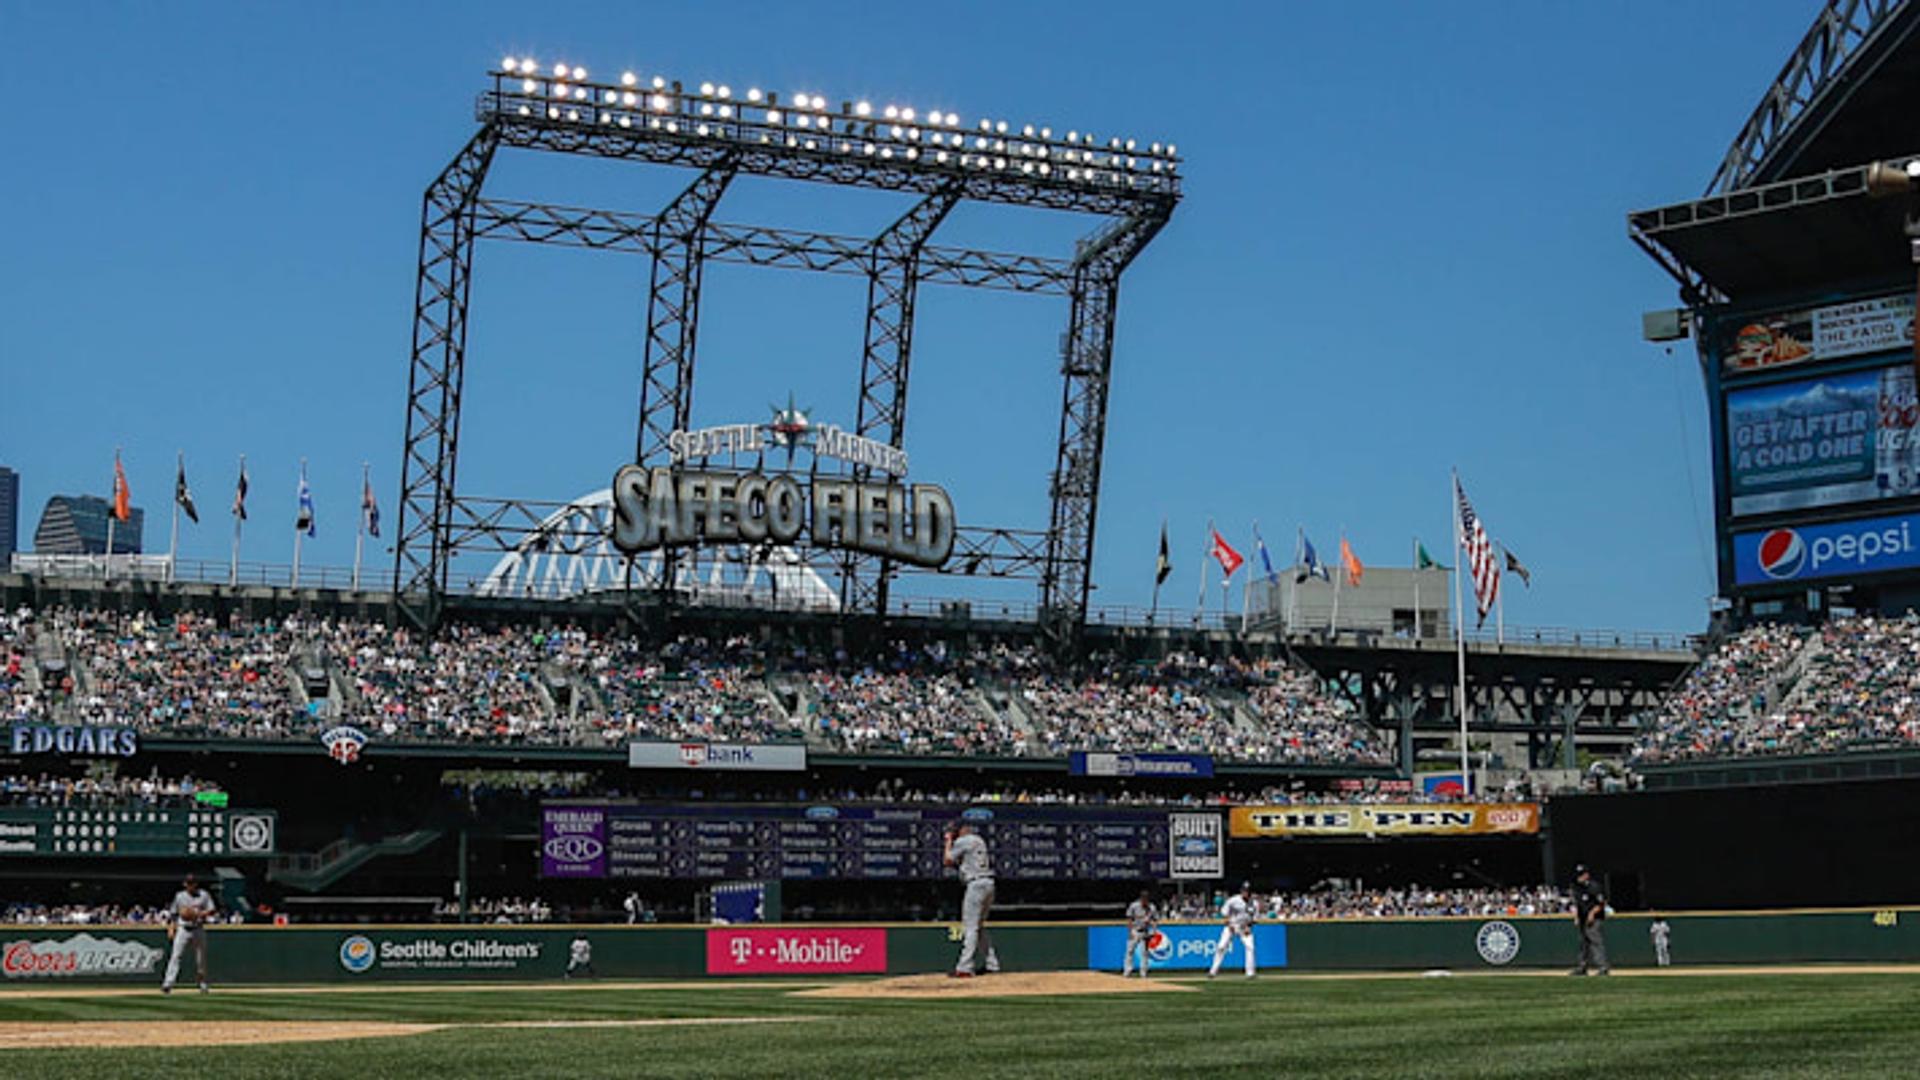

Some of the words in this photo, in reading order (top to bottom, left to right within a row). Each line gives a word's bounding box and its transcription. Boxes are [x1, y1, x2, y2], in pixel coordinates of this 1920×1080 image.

[1736, 421, 1783, 448] GET
[1789, 410, 1868, 440] AFTER
[669, 423, 764, 463] SEATTLE
[814, 423, 910, 478] MARINERS
[1737, 450, 1751, 470] A
[1755, 441, 1814, 468] COLD
[1817, 434, 1865, 459] ONE
[613, 464, 804, 554] SAFECO
[811, 473, 955, 568] FIELD
[1811, 520, 1911, 570] pepsi
[11, 727, 137, 756] EDGARS
[708, 744, 754, 763] bank
[1173, 818, 1216, 836] BUILT
[1253, 812, 1350, 828] THE
[3, 940, 78, 973] Coors
[79, 949, 159, 973] LIGHT
[380, 940, 446, 959] Seattle
[449, 940, 540, 959] Children's
